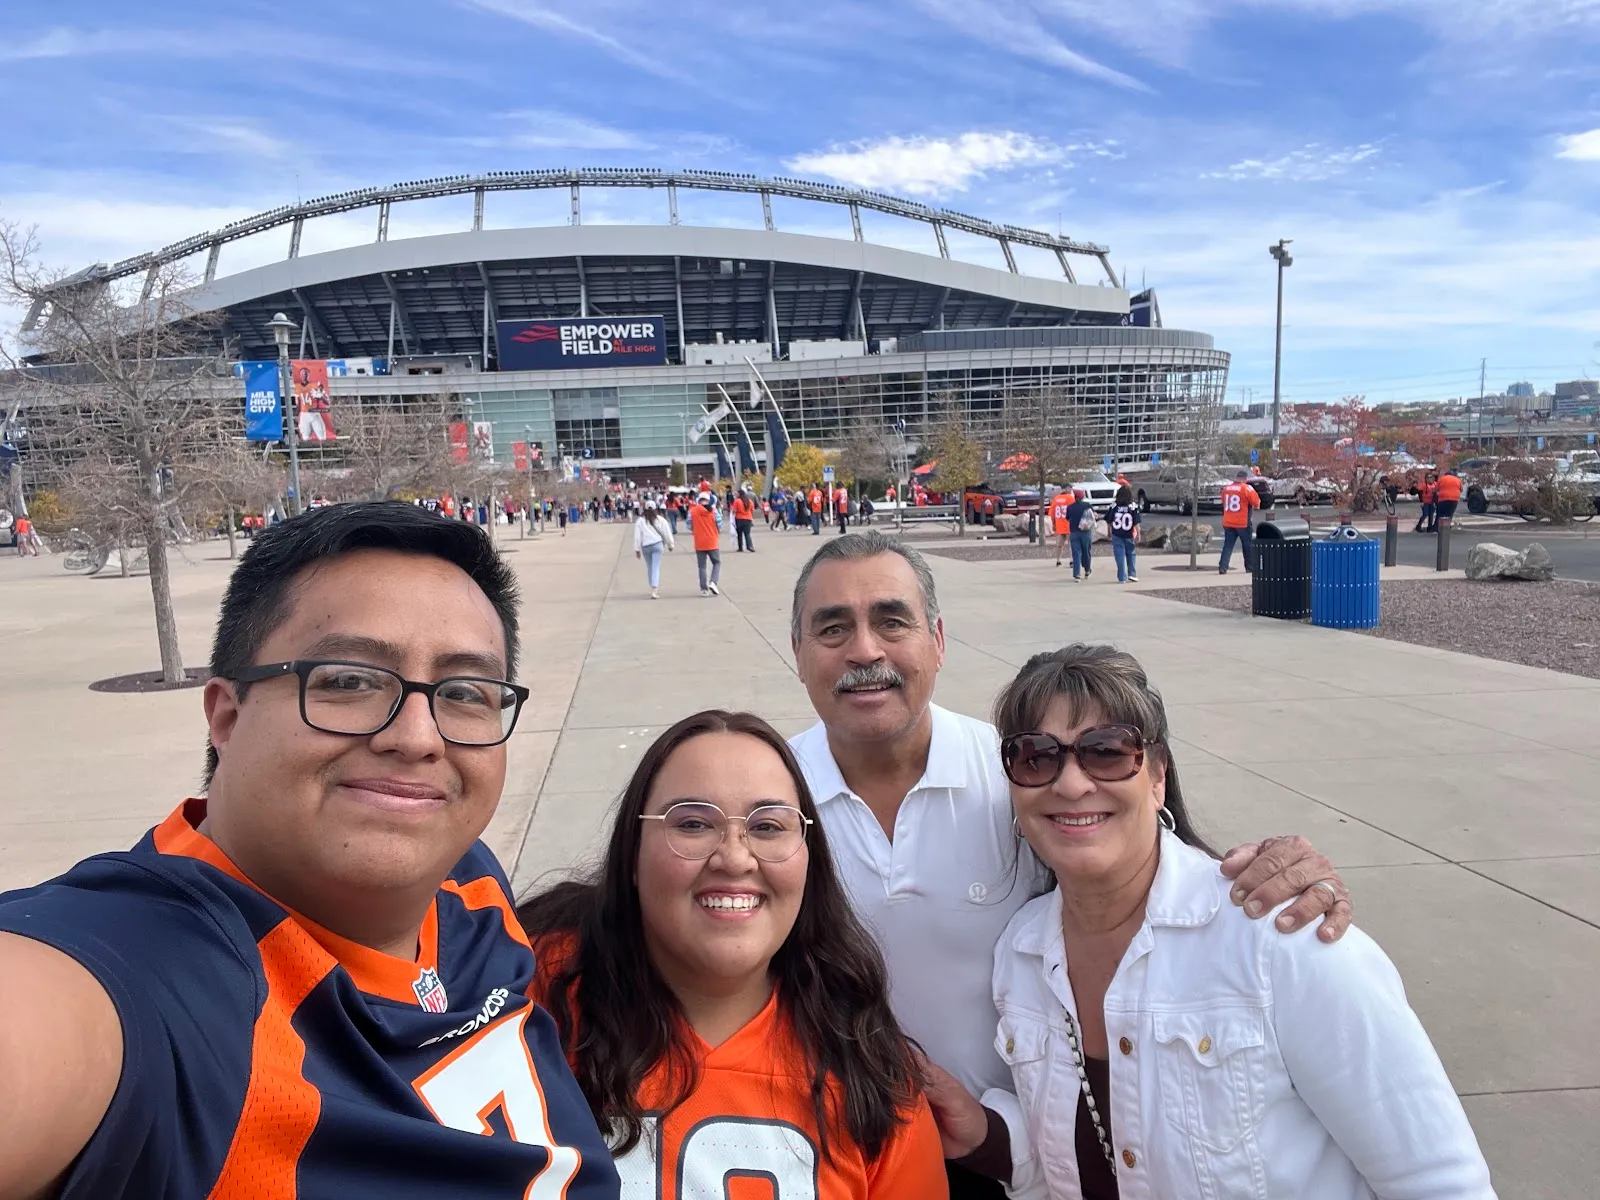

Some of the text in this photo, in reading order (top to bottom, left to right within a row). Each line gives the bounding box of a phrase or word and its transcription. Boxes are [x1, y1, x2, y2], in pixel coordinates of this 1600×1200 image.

[560, 323, 655, 340] EMPOWER
[562, 340, 613, 355] FIELD
[635, 345, 656, 353] HIGH
[251, 391, 275, 399] MILE
[300, 393, 313, 406] 14
[250, 398, 276, 406] HIGH
[250, 405, 275, 413] CITY
[584, 449, 592, 458] 2
[1224, 493, 1241, 512] 18
[1112, 512, 1133, 531] 30
